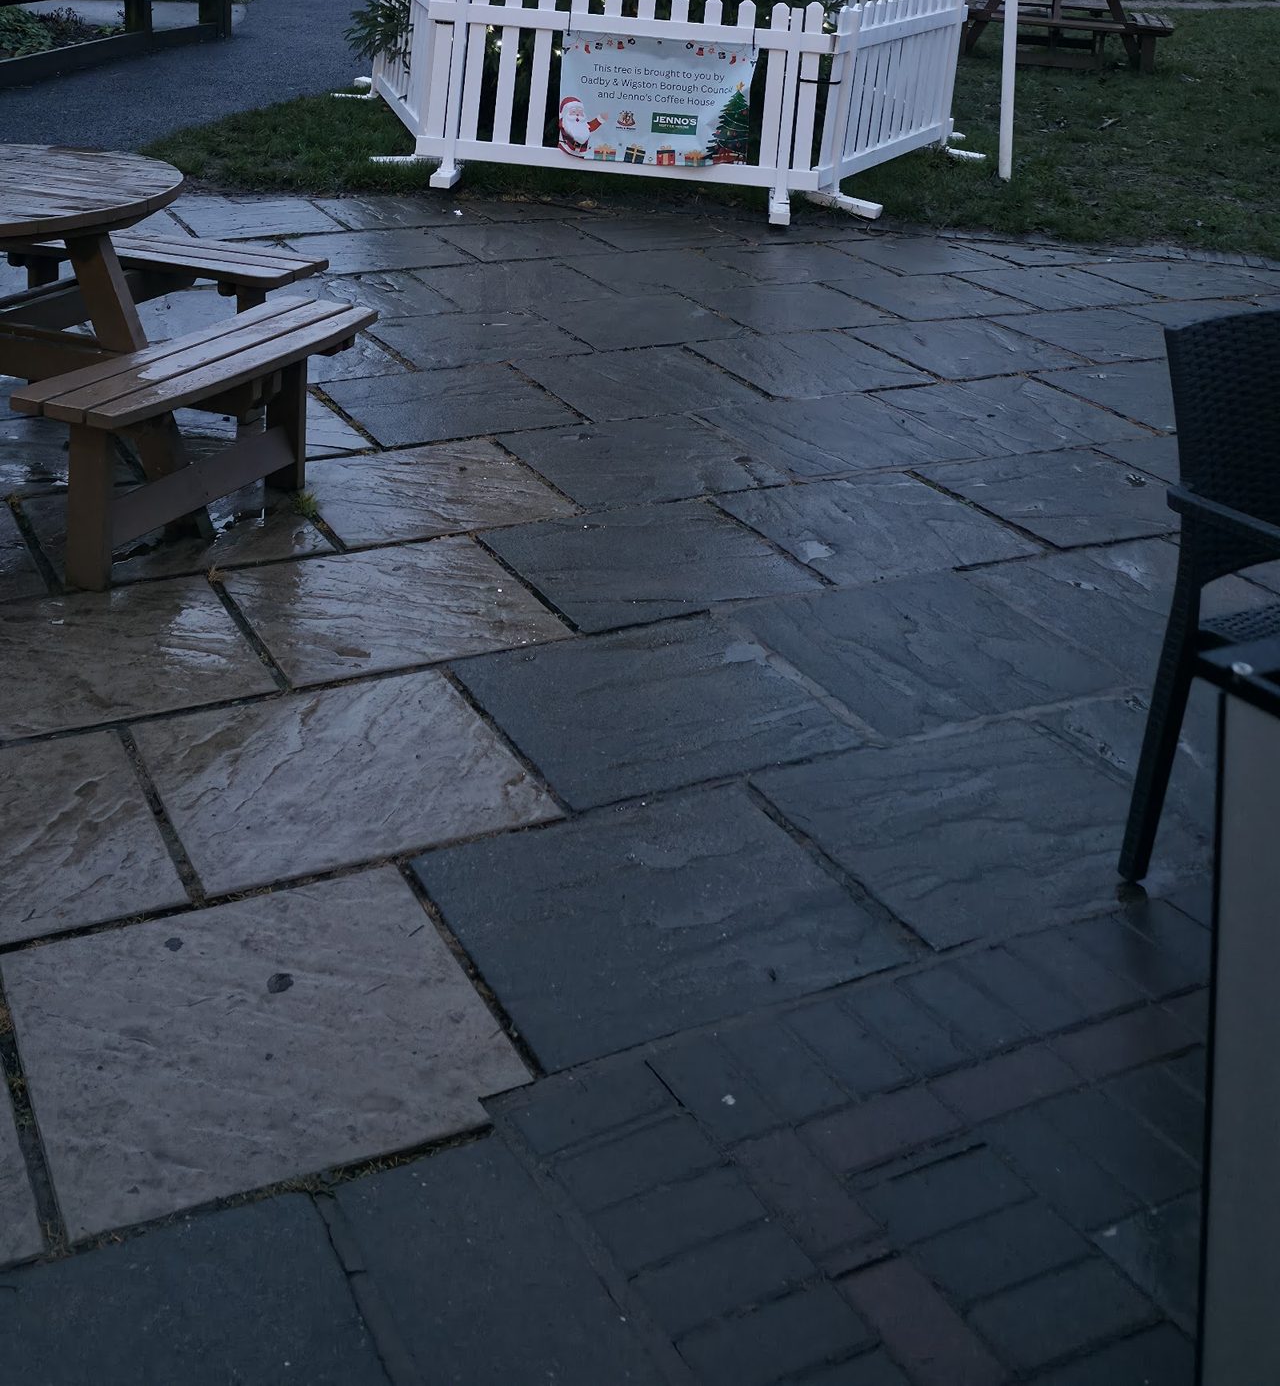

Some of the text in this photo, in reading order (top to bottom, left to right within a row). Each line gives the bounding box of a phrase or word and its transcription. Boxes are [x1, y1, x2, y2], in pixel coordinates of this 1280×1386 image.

[594, 64, 725, 82] This tree is brought to you by
[581, 76, 611, 87] Oadby
[612, 78, 619, 86] &
[621, 79, 658, 90] Wigston
[660, 82, 699, 94] Borough
[598, 90, 715, 107] and Jenno's Coffee House
[653, 116, 697, 126] JENNO'S
